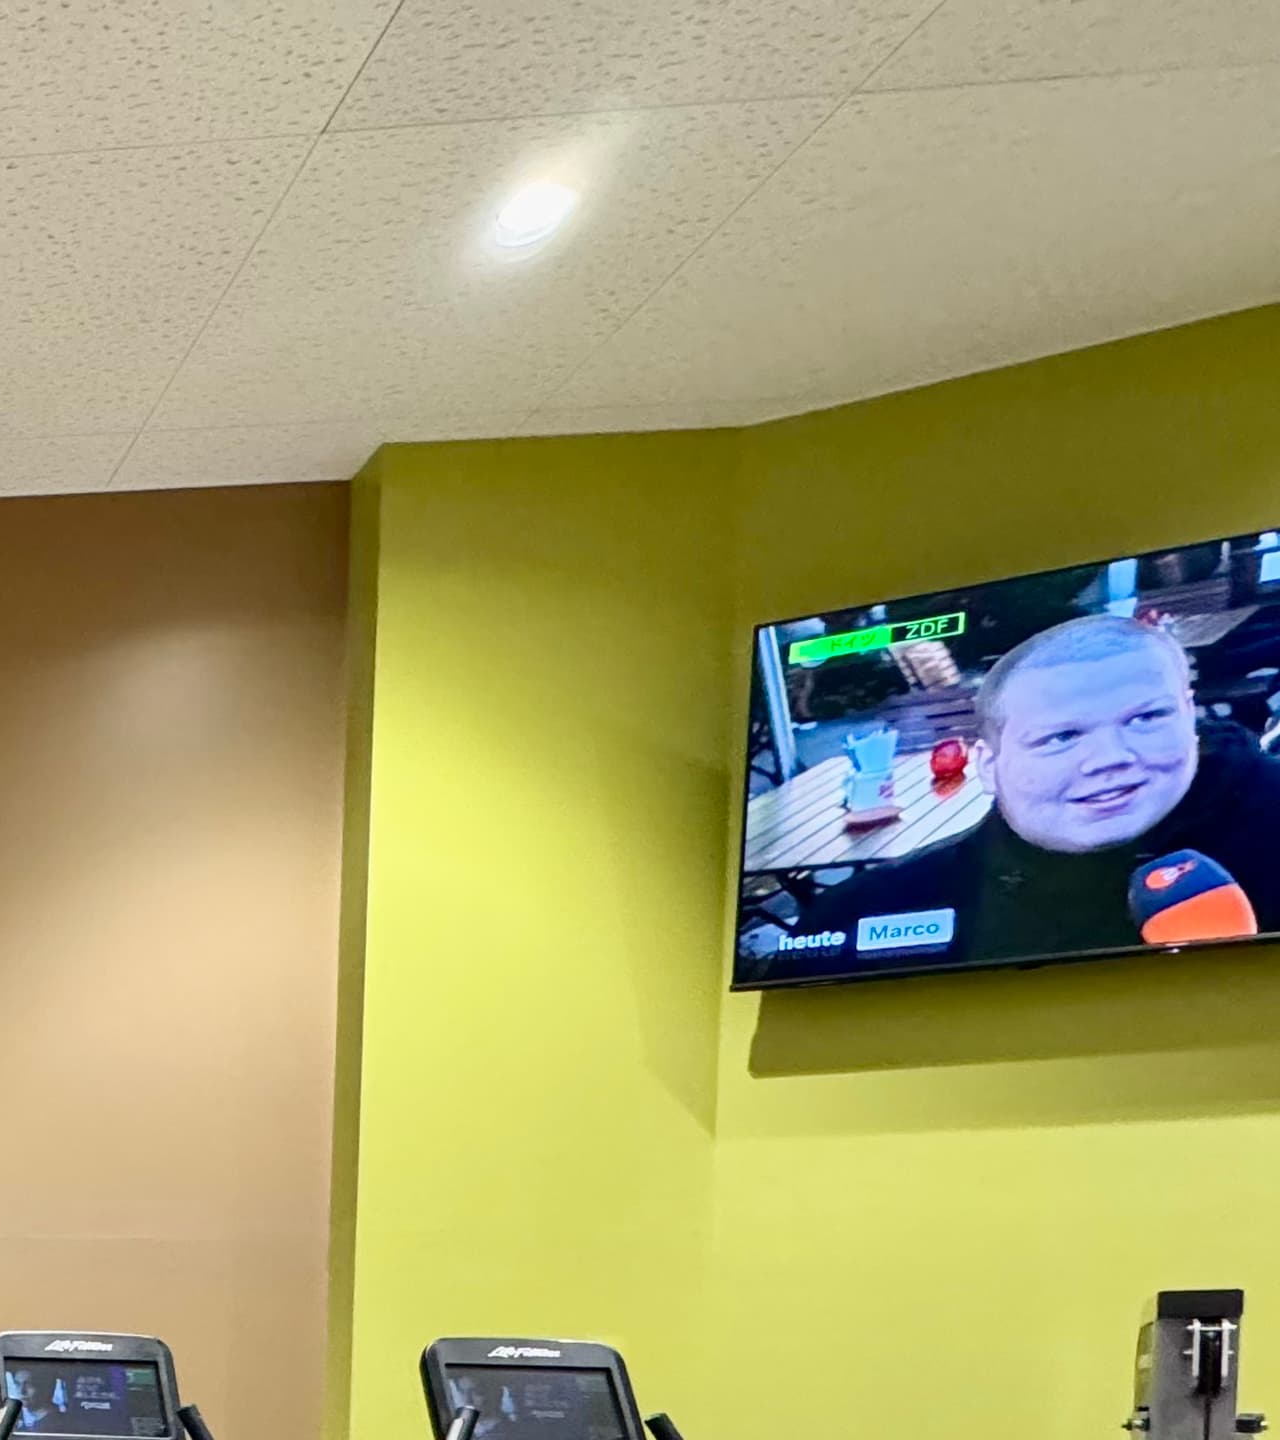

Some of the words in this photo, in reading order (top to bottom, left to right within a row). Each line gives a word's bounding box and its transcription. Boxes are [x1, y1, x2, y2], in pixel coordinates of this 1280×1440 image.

[905, 619, 949, 640] ZDF
[830, 632, 876, 652] ドイツ
[779, 931, 846, 951] heute
[869, 923, 940, 941] Marco
